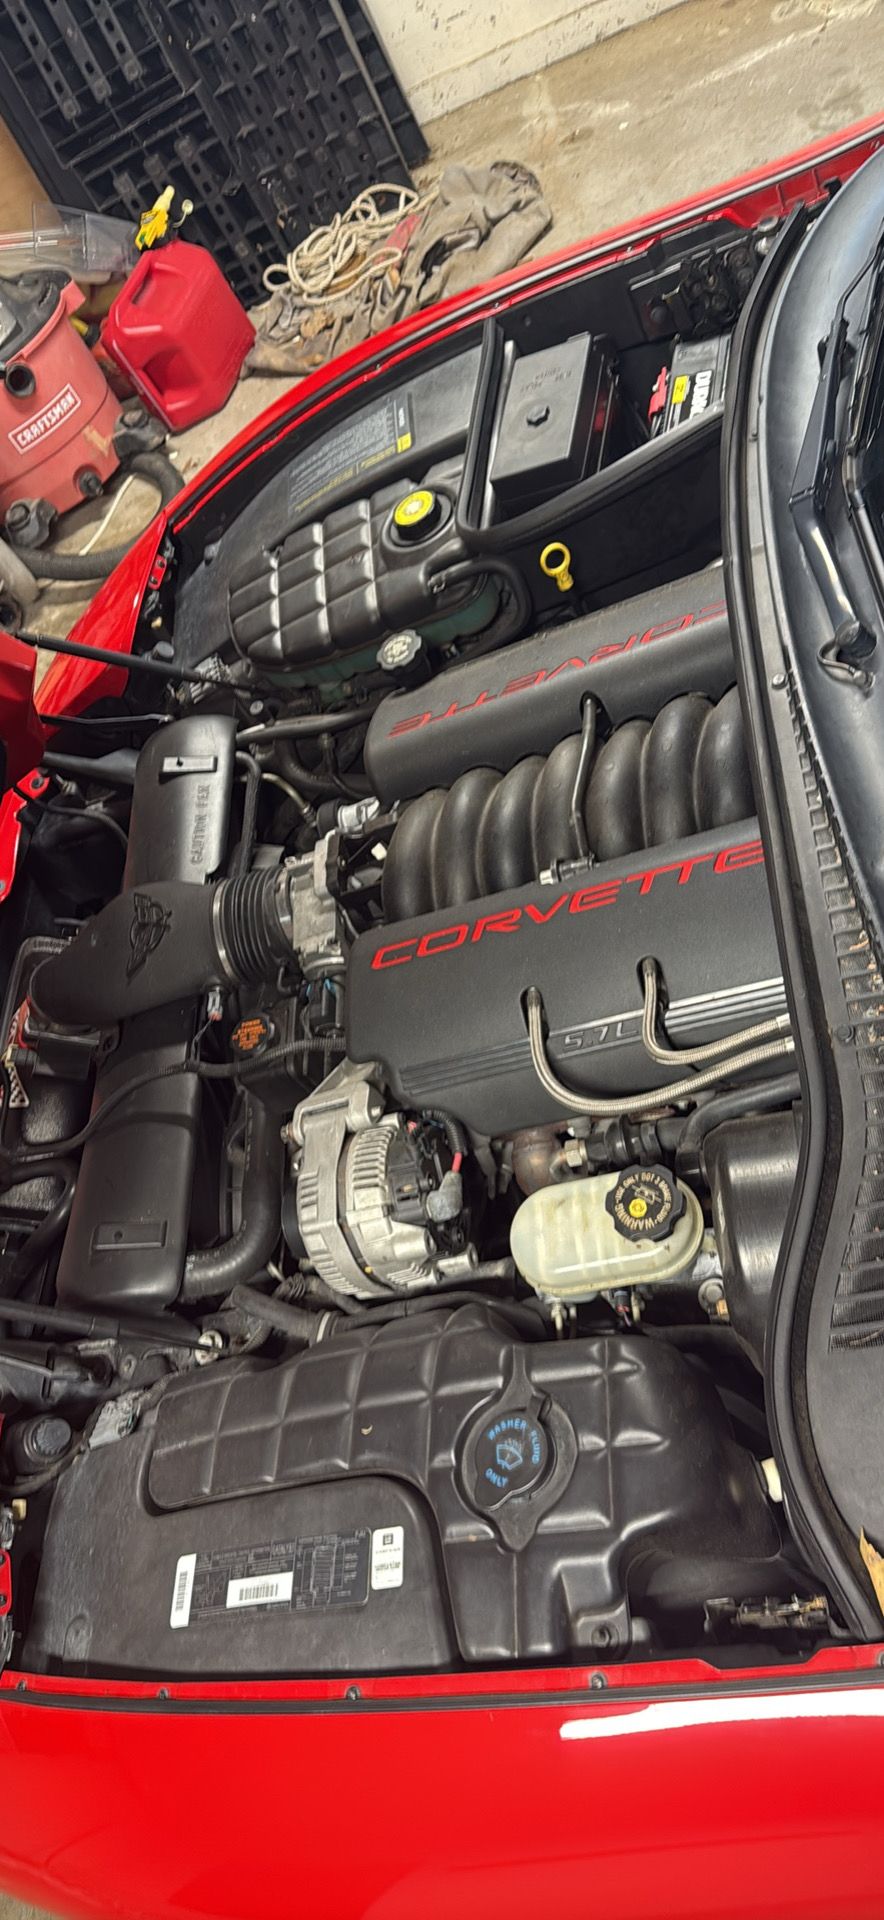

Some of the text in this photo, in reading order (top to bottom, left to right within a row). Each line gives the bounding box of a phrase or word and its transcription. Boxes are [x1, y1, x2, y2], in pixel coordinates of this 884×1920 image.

[17, 391, 75, 446] CRAFTSMAN
[371, 839, 764, 969] CORVETTE
[564, 1021, 638, 1050] 5.7L
[488, 1418, 540, 1464] WASHER FLUID
[485, 1468, 508, 1487] ONLY
